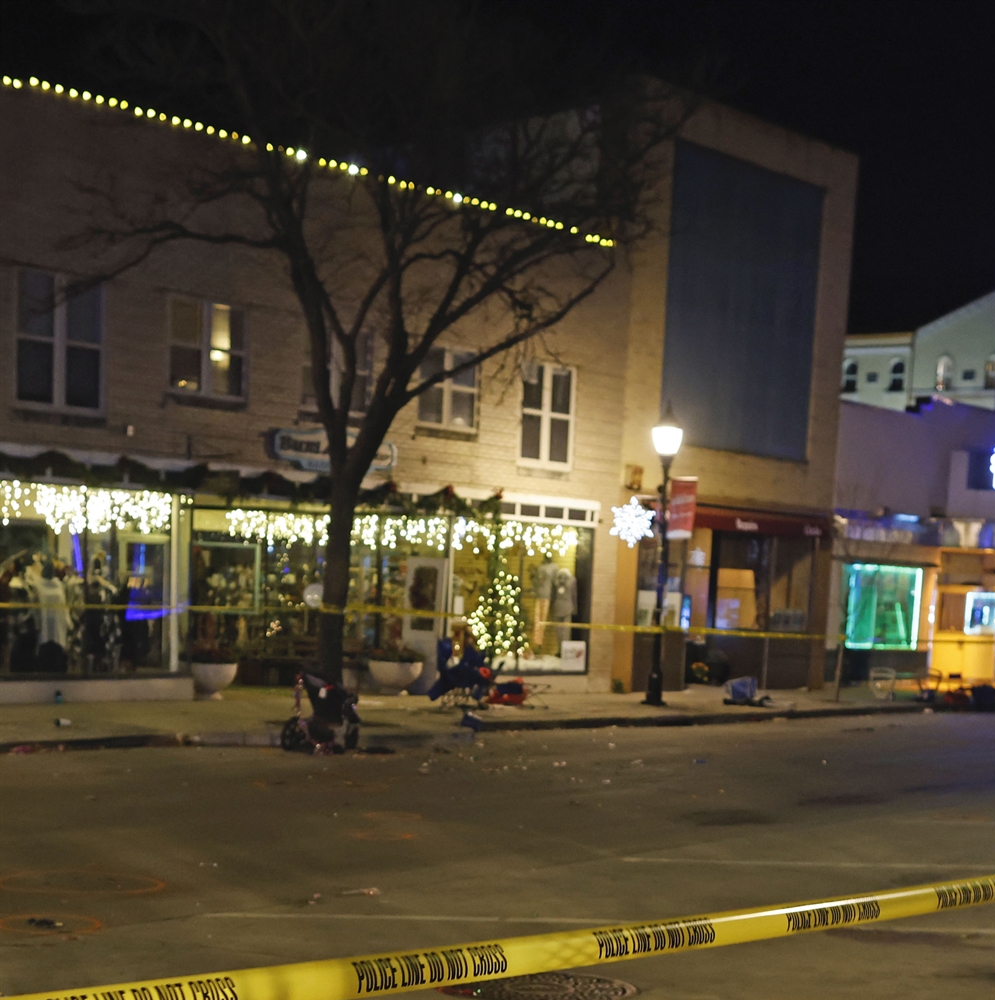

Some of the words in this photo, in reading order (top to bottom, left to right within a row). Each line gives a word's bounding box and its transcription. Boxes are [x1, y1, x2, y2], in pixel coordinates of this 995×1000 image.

[351, 957, 398, 994] POLICE
[395, 952, 426, 988] LINE
[423, 951, 445, 984] DO
[441, 948, 468, 981] NOT
[466, 943, 508, 977] CROSS
